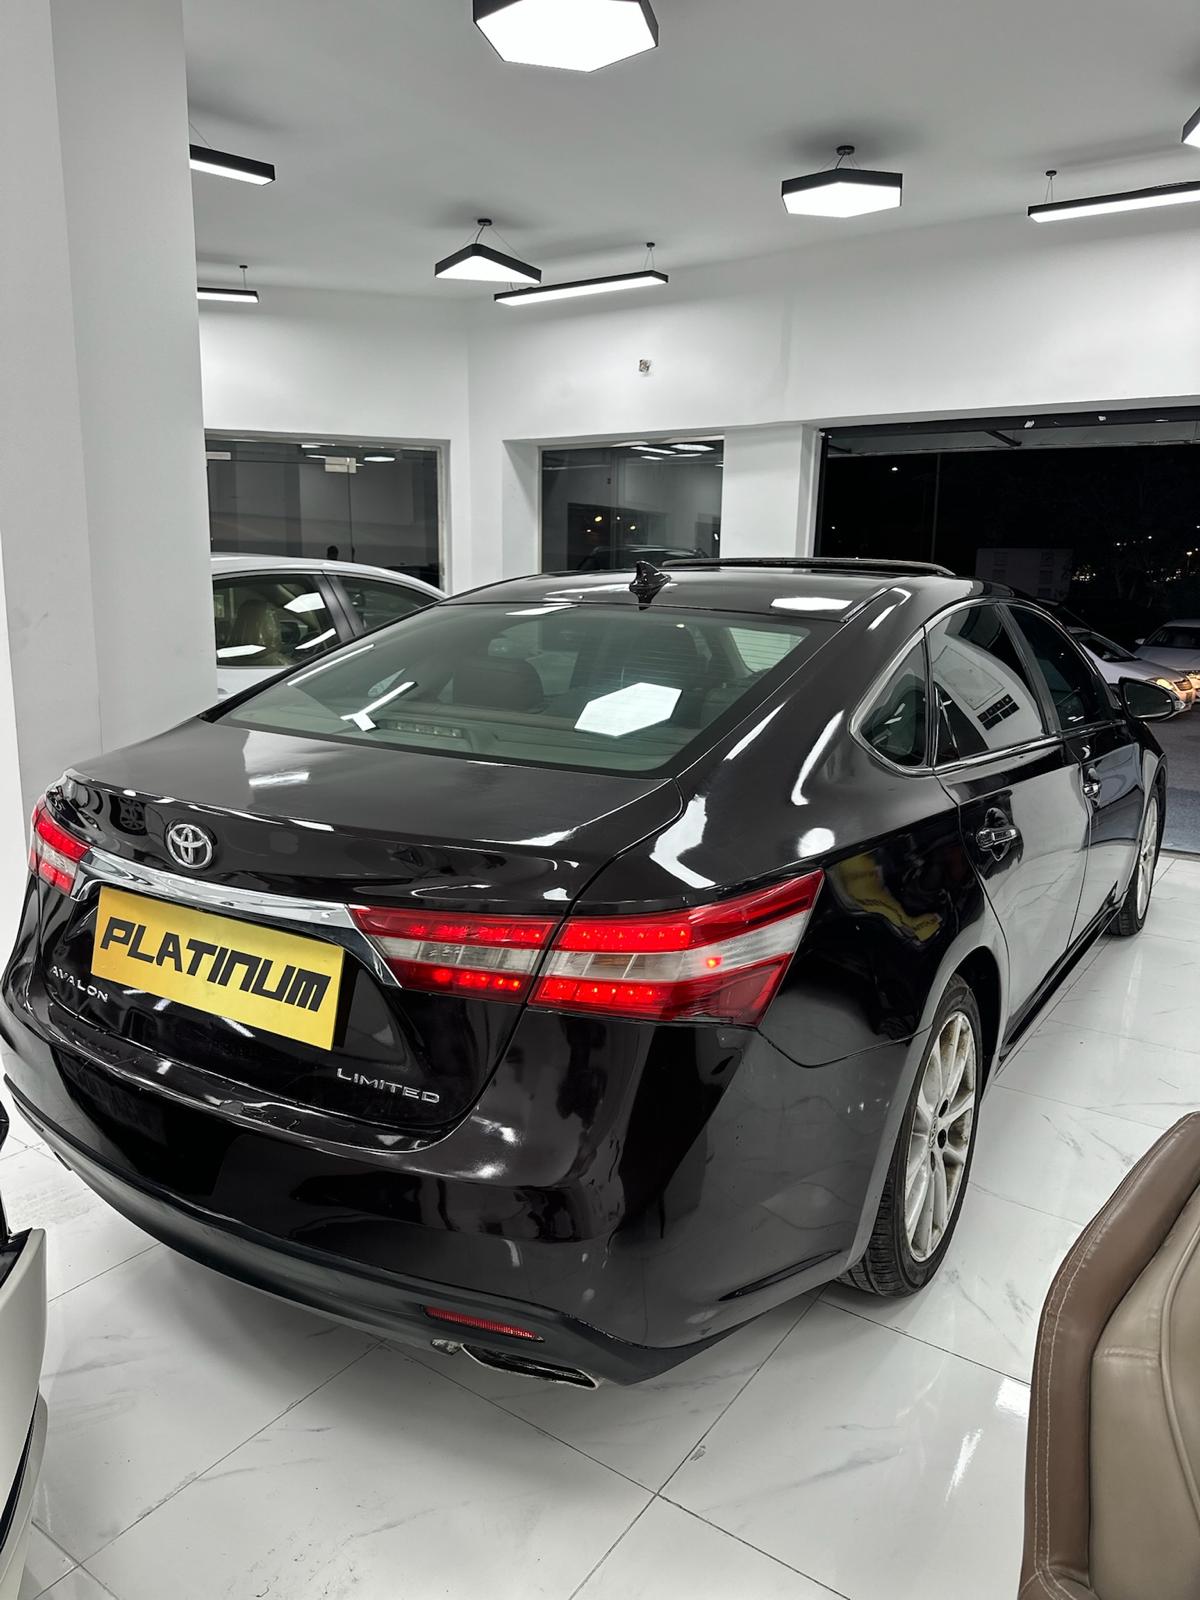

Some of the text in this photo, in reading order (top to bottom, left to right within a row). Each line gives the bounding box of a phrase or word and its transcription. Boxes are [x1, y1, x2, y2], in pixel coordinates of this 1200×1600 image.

[100, 917, 331, 1012] PLATINUM
[49, 966, 108, 1002] AVALON
[337, 1068, 440, 1103] LIMITED
